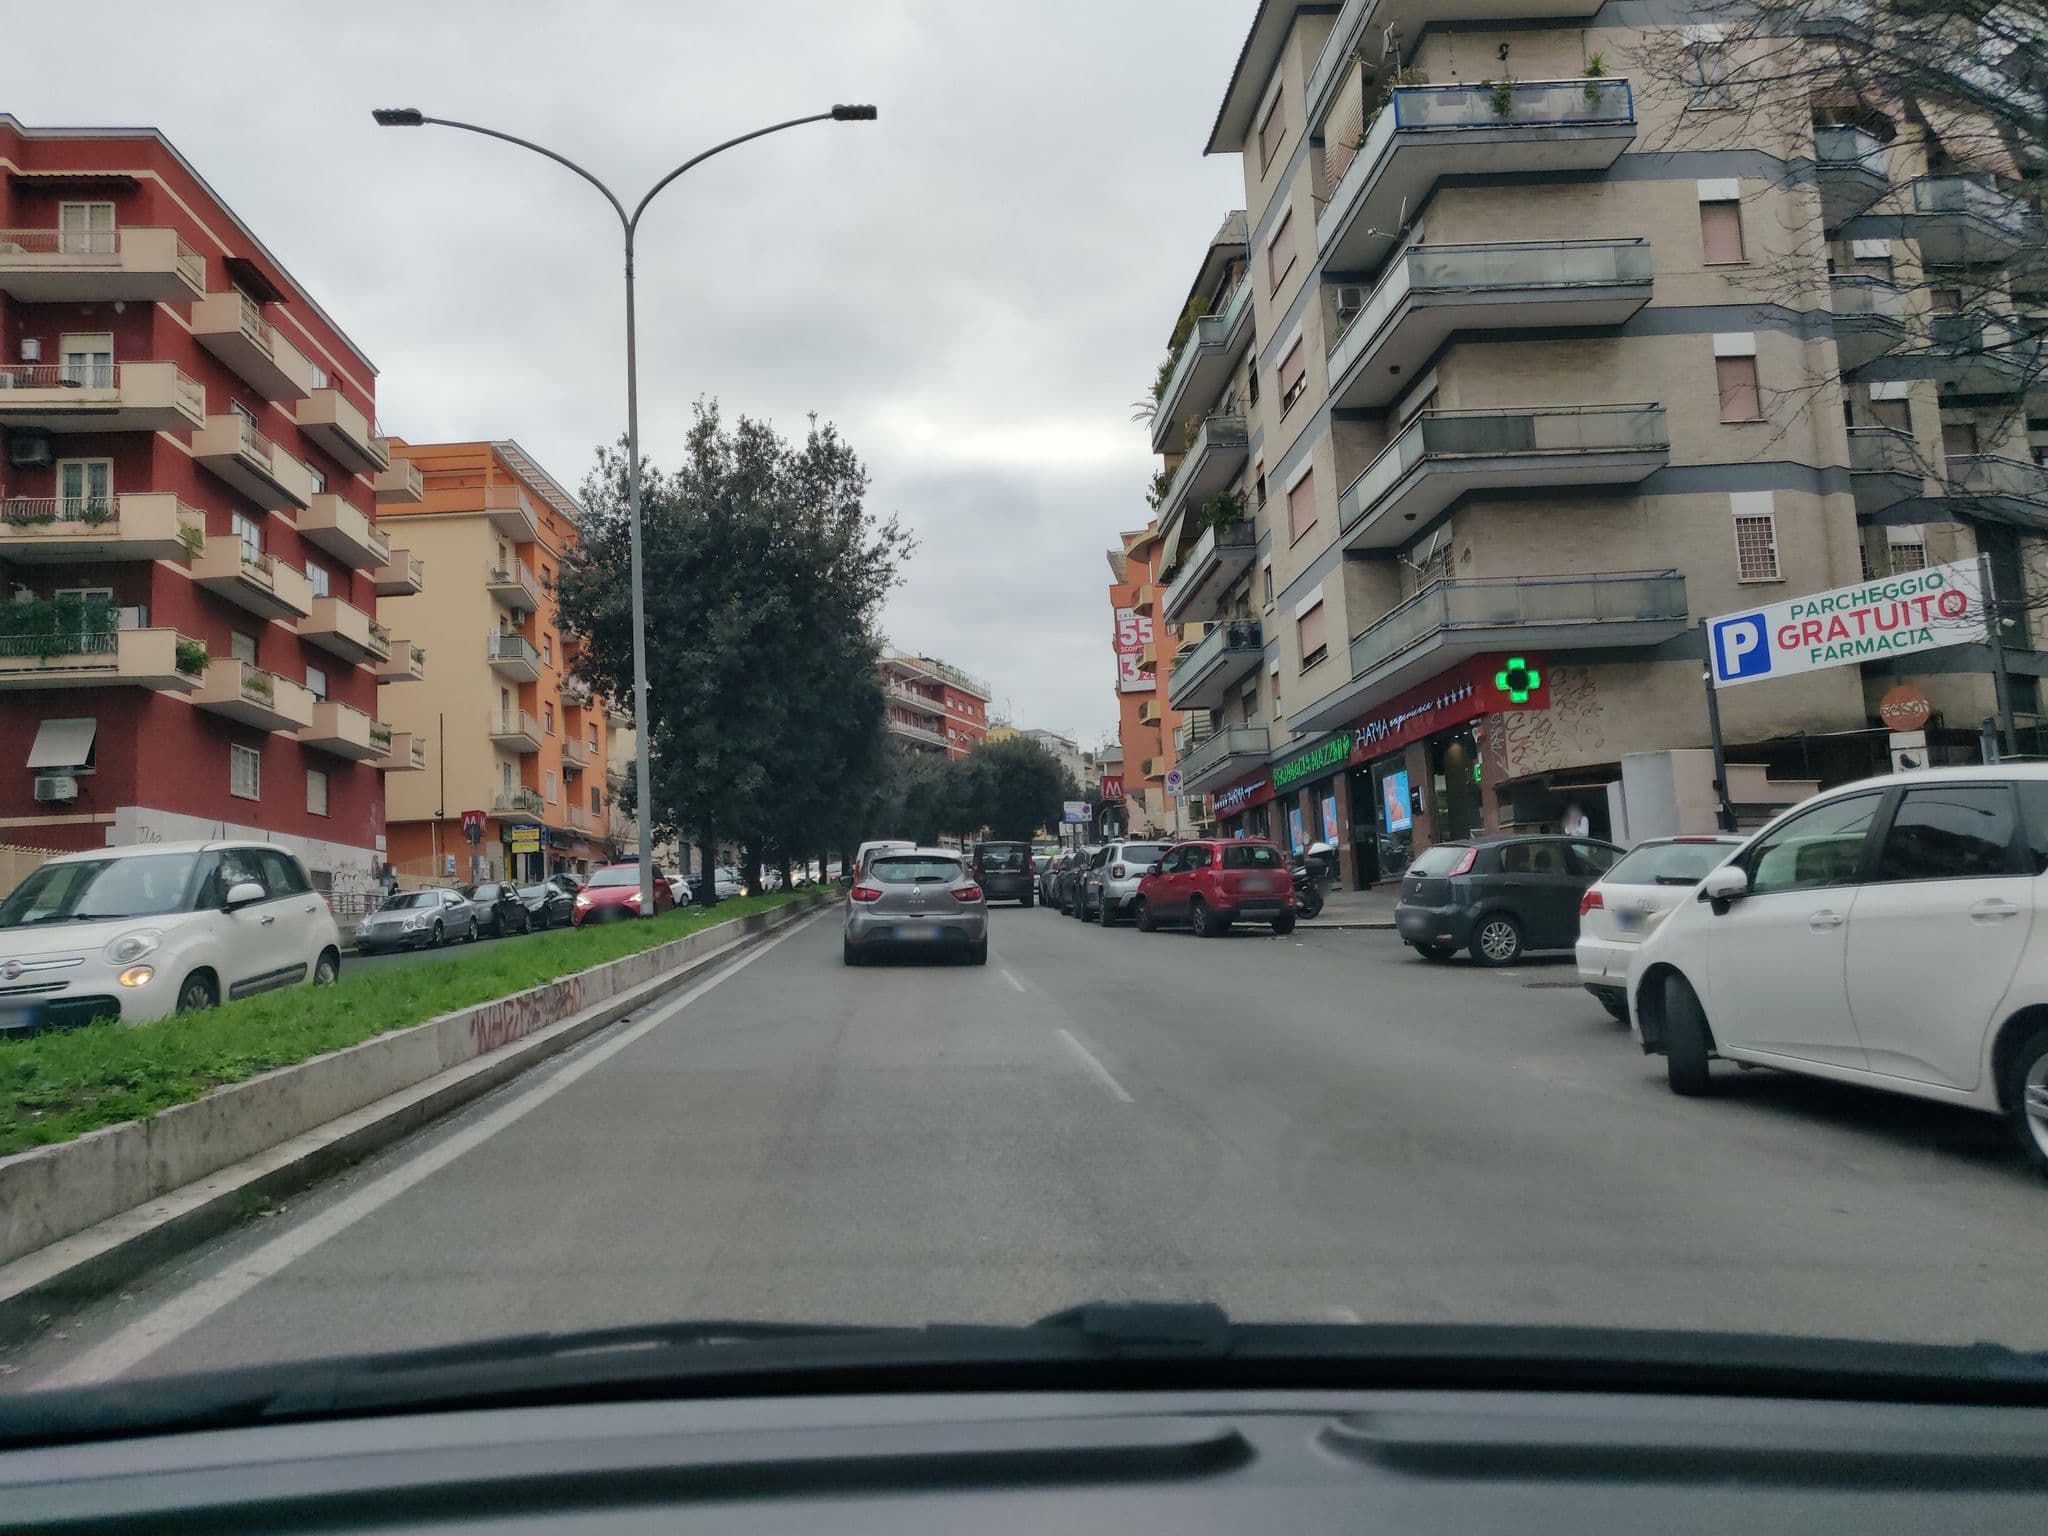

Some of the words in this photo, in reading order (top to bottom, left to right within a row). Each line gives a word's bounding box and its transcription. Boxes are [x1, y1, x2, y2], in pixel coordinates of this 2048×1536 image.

[1777, 590, 1968, 651] GRATUITO
[1790, 572, 1945, 621] PARCHEGGIO
[1722, 622, 1759, 676] P
[1810, 628, 1934, 664] FARMACIA
